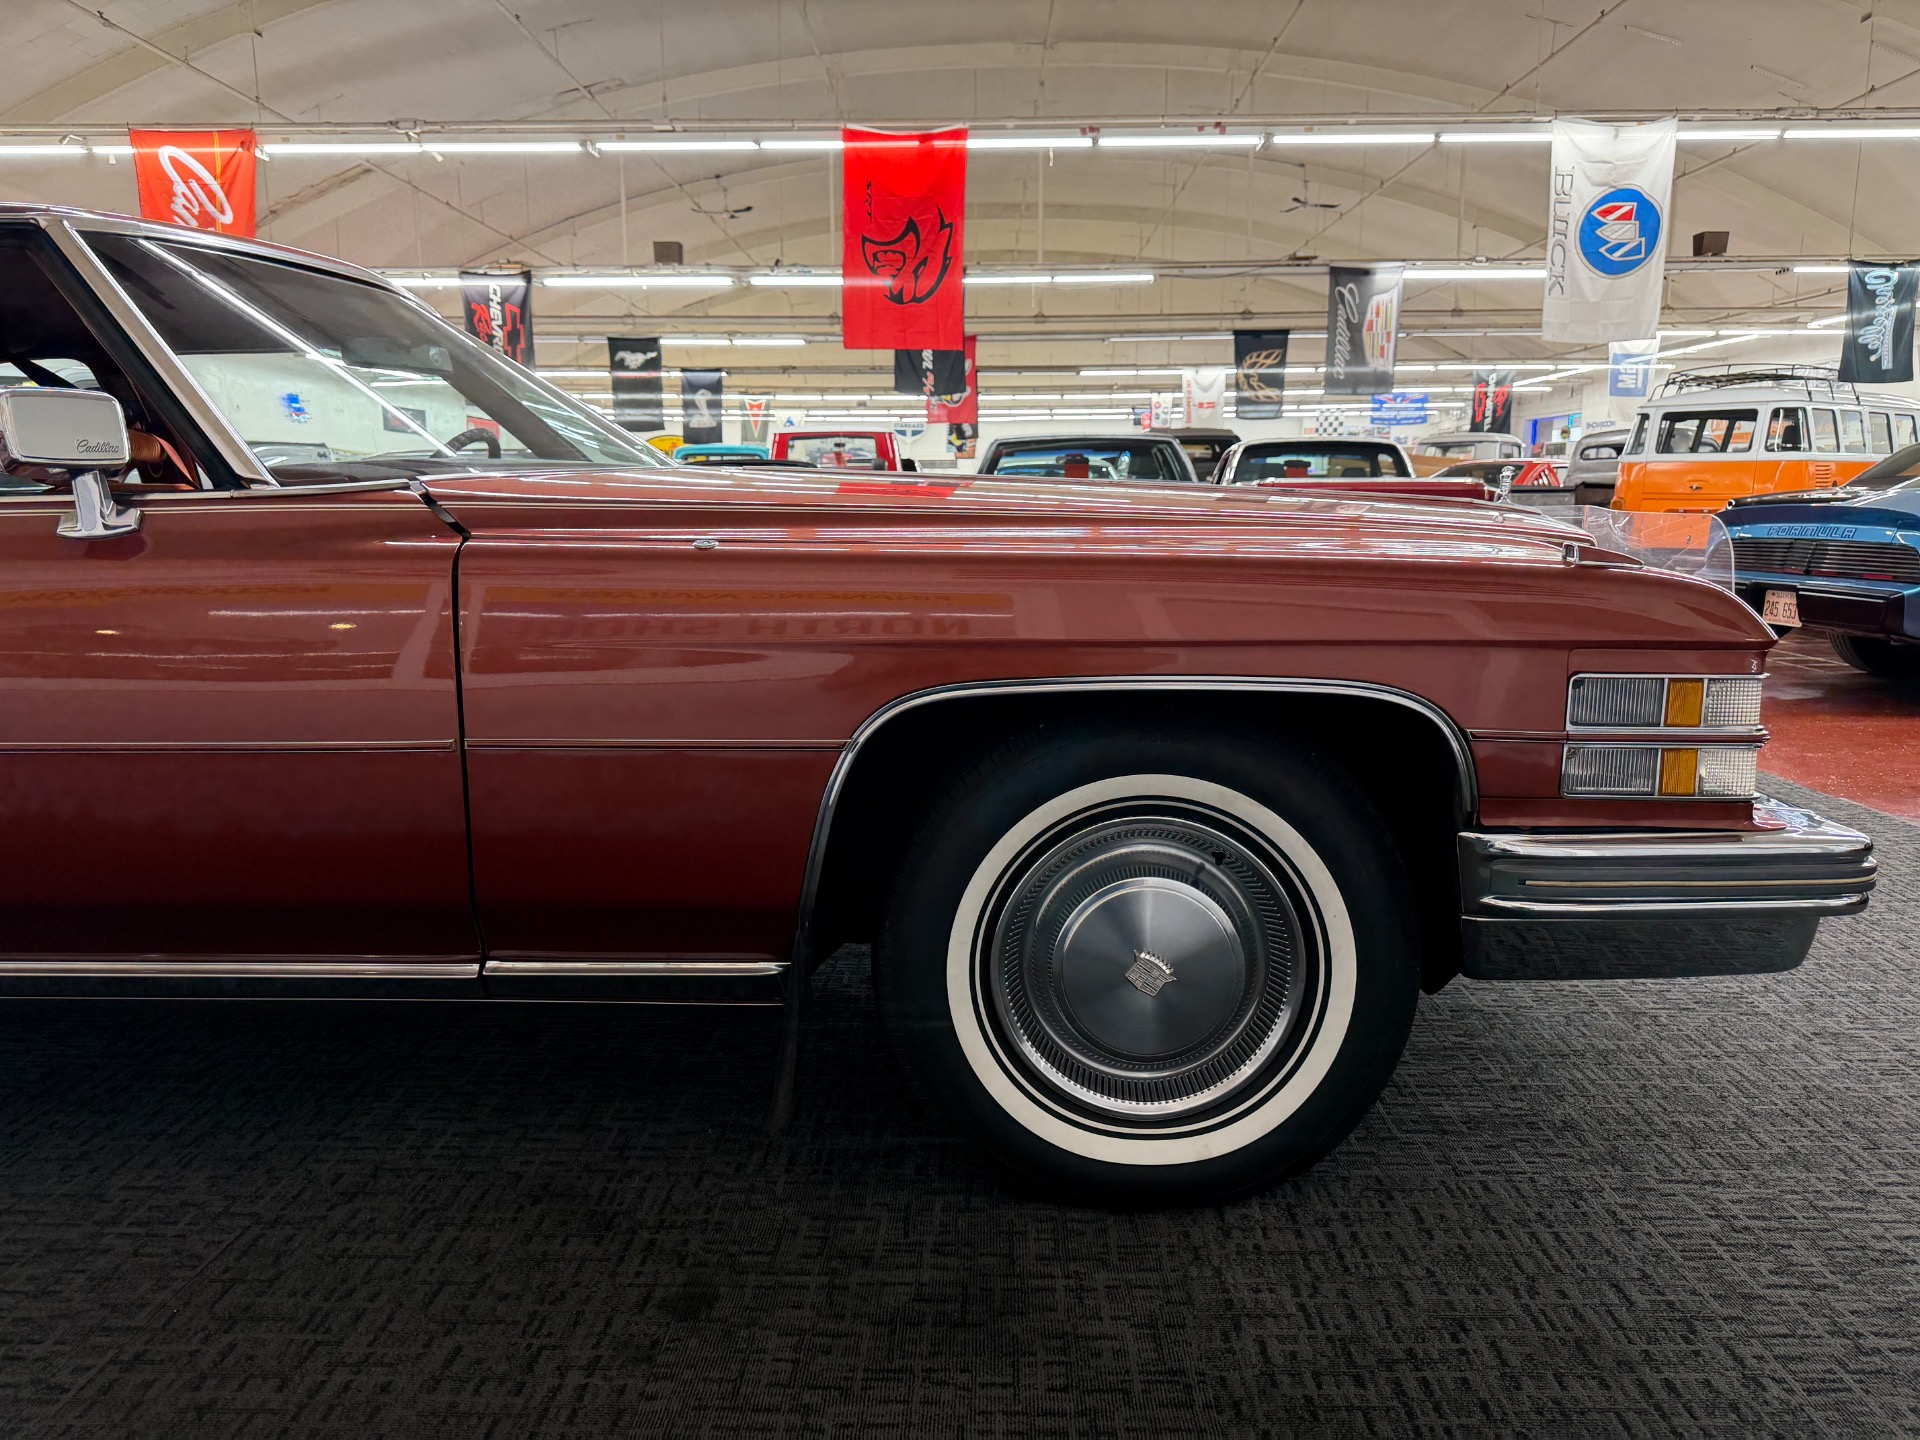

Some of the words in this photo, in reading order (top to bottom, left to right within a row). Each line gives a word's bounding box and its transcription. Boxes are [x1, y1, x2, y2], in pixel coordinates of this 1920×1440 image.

[1548, 165, 1576, 297] BUICK
[1333, 282, 1360, 380] Cadillac
[76, 439, 119, 453] Cadillac
[1767, 525, 1858, 539] FORMULA
[1764, 600, 1780, 617] 245
